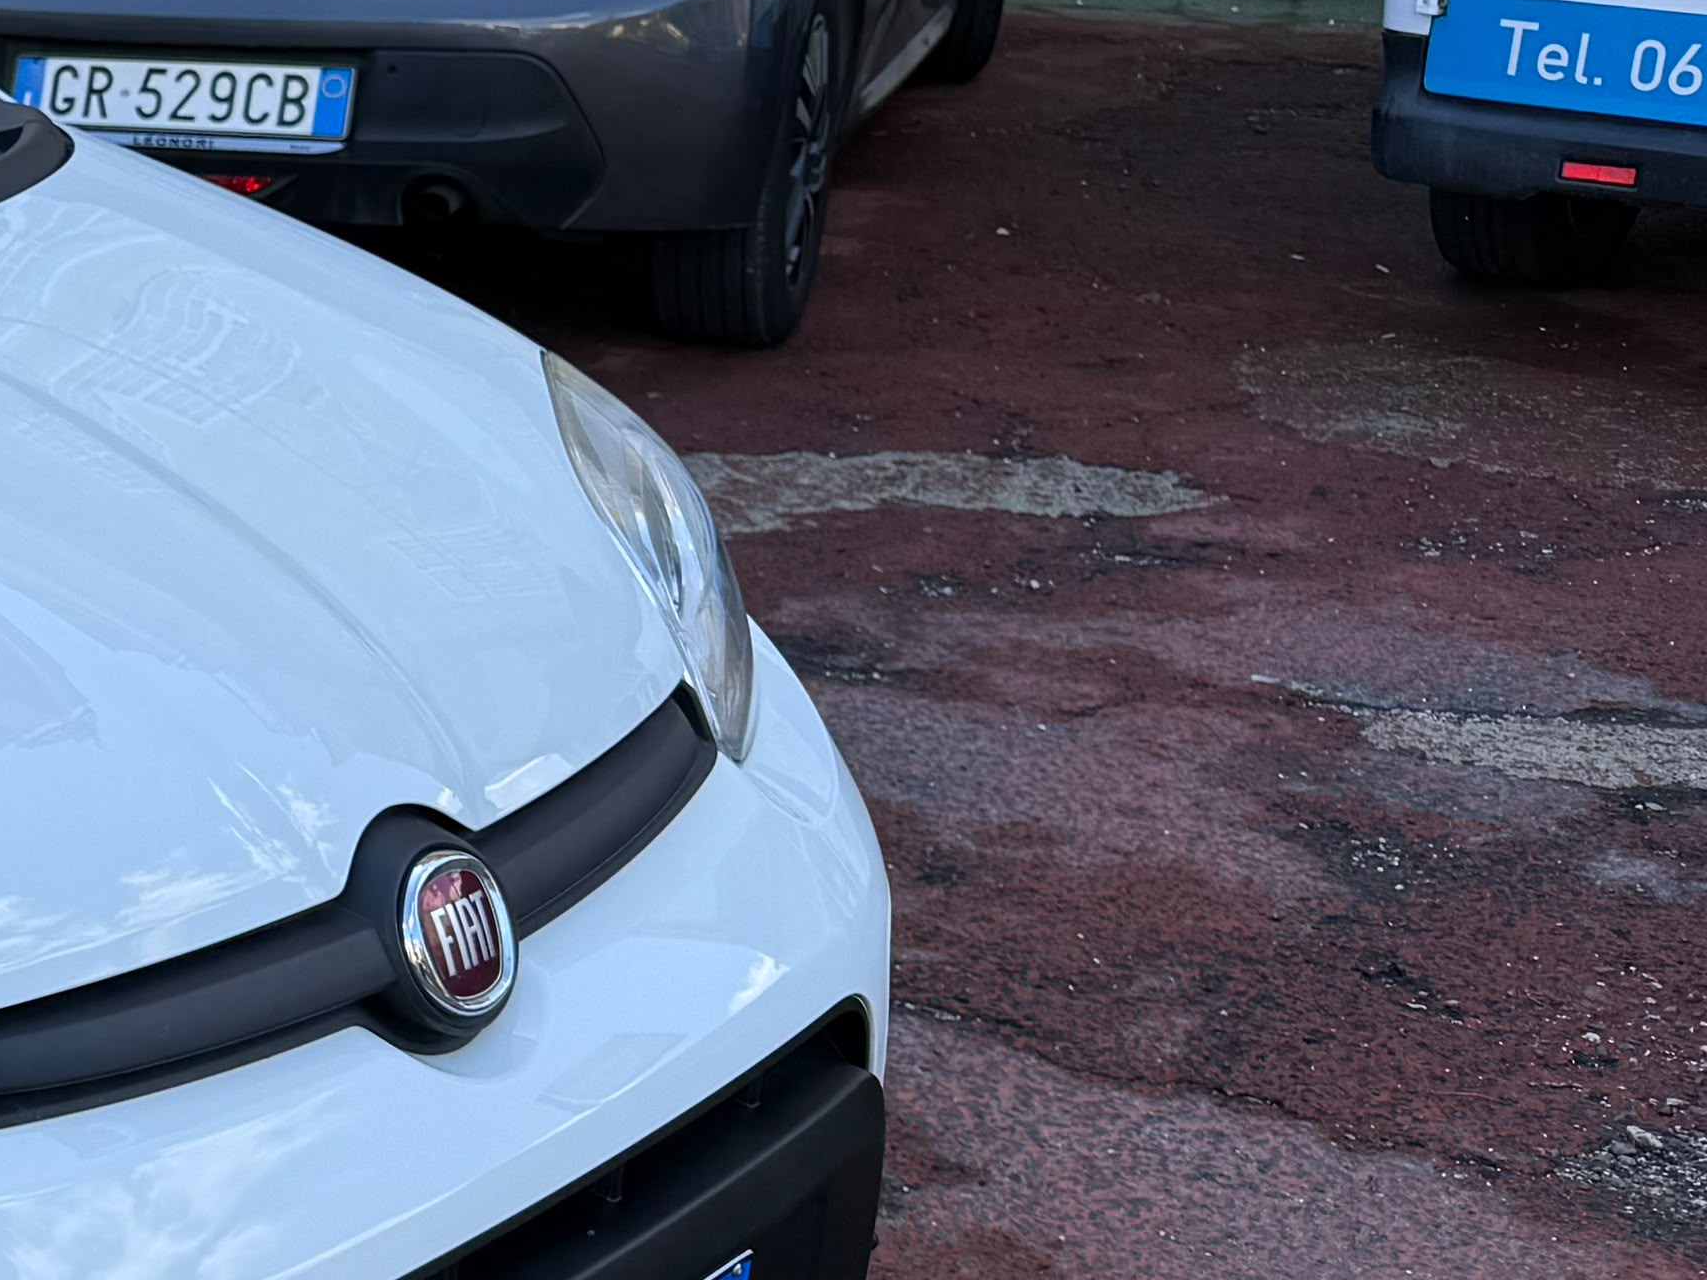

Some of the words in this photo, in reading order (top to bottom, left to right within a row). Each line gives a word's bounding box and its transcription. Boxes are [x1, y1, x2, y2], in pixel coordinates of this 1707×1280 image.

[49, 65, 114, 119] GR
[135, 67, 309, 127] 529CB
[1500, 18, 1602, 86] Tel.
[1630, 39, 1703, 96] 06
[430, 889, 496, 977] FIAT
